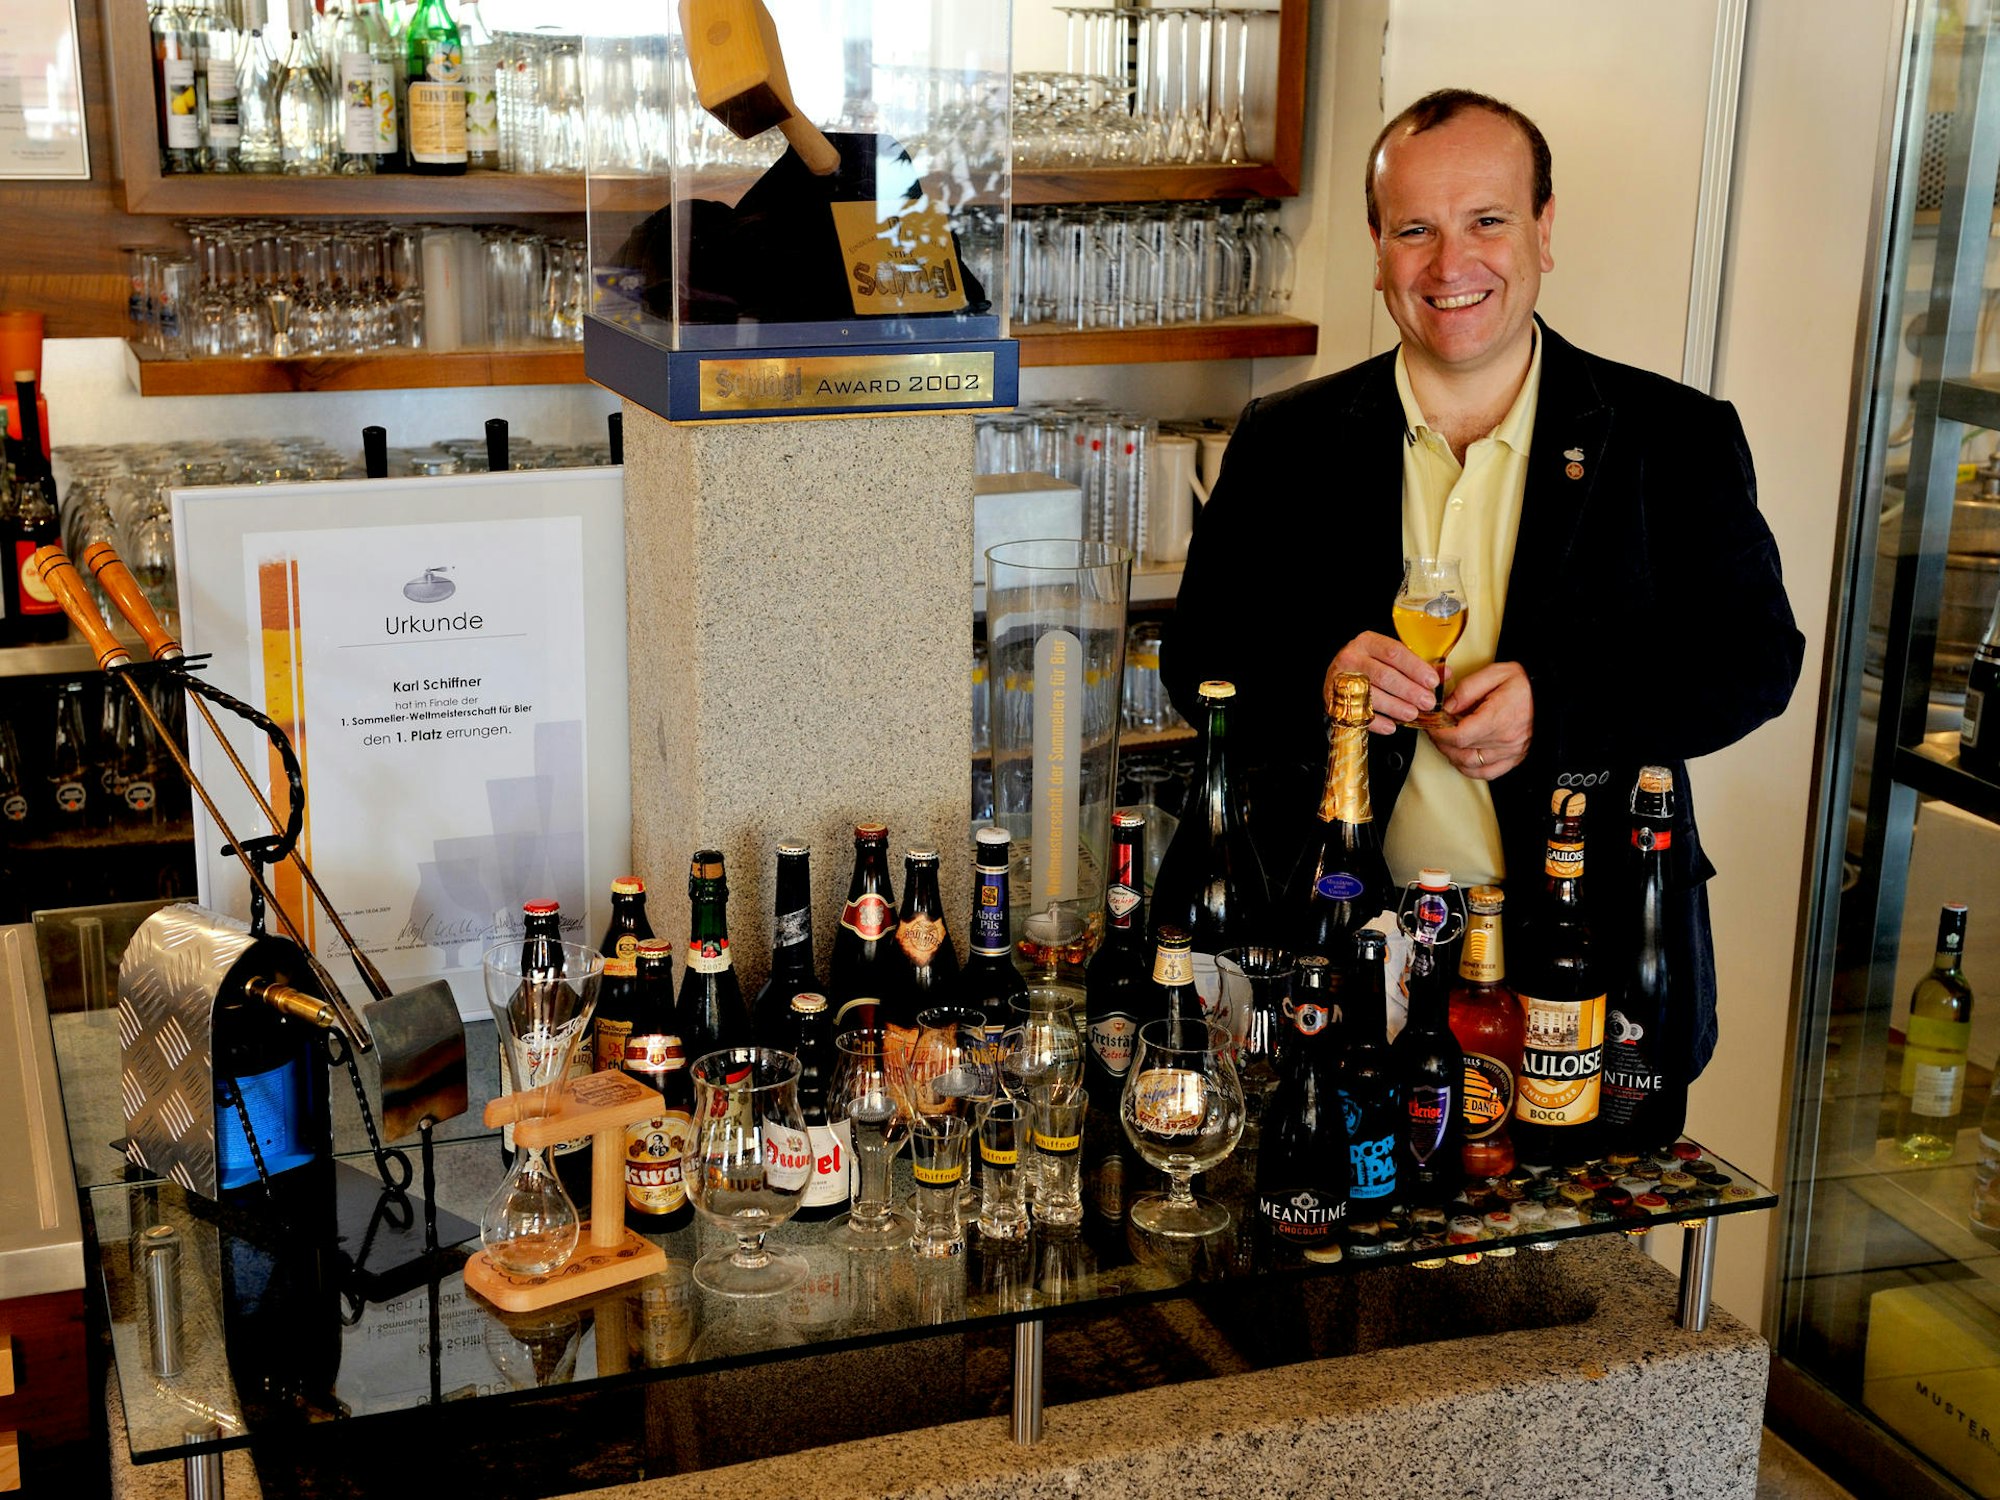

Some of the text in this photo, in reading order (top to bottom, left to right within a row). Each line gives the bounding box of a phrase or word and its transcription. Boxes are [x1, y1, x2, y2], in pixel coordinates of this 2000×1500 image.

[908, 374, 980, 392] 2002
[385, 612, 483, 635] Urkunde
[393, 677, 482, 693] Karl Schiffner
[395, 696, 478, 711] hat im Finale der
[341, 704, 532, 727] 1. Sommelier-Weltmeisterschaft für Bier
[363, 725, 512, 746] den 1. Platz errungen.
[1046, 639, 1066, 896] Weltmeisterschaft der Sommeliere für Bier
[975, 909, 1003, 920] Abtei
[980, 920, 999, 930] Pils
[1471, 1098, 1498, 1115] DANCE
[1529, 1108, 1566, 1122] BOCQ
[916, 1169, 960, 1181] Schiffner
[1259, 1197, 1347, 1224] MEANTIME
[1278, 1224, 1328, 1235] CHOCOLATE
[1915, 1381, 1990, 1441] MUSTER
